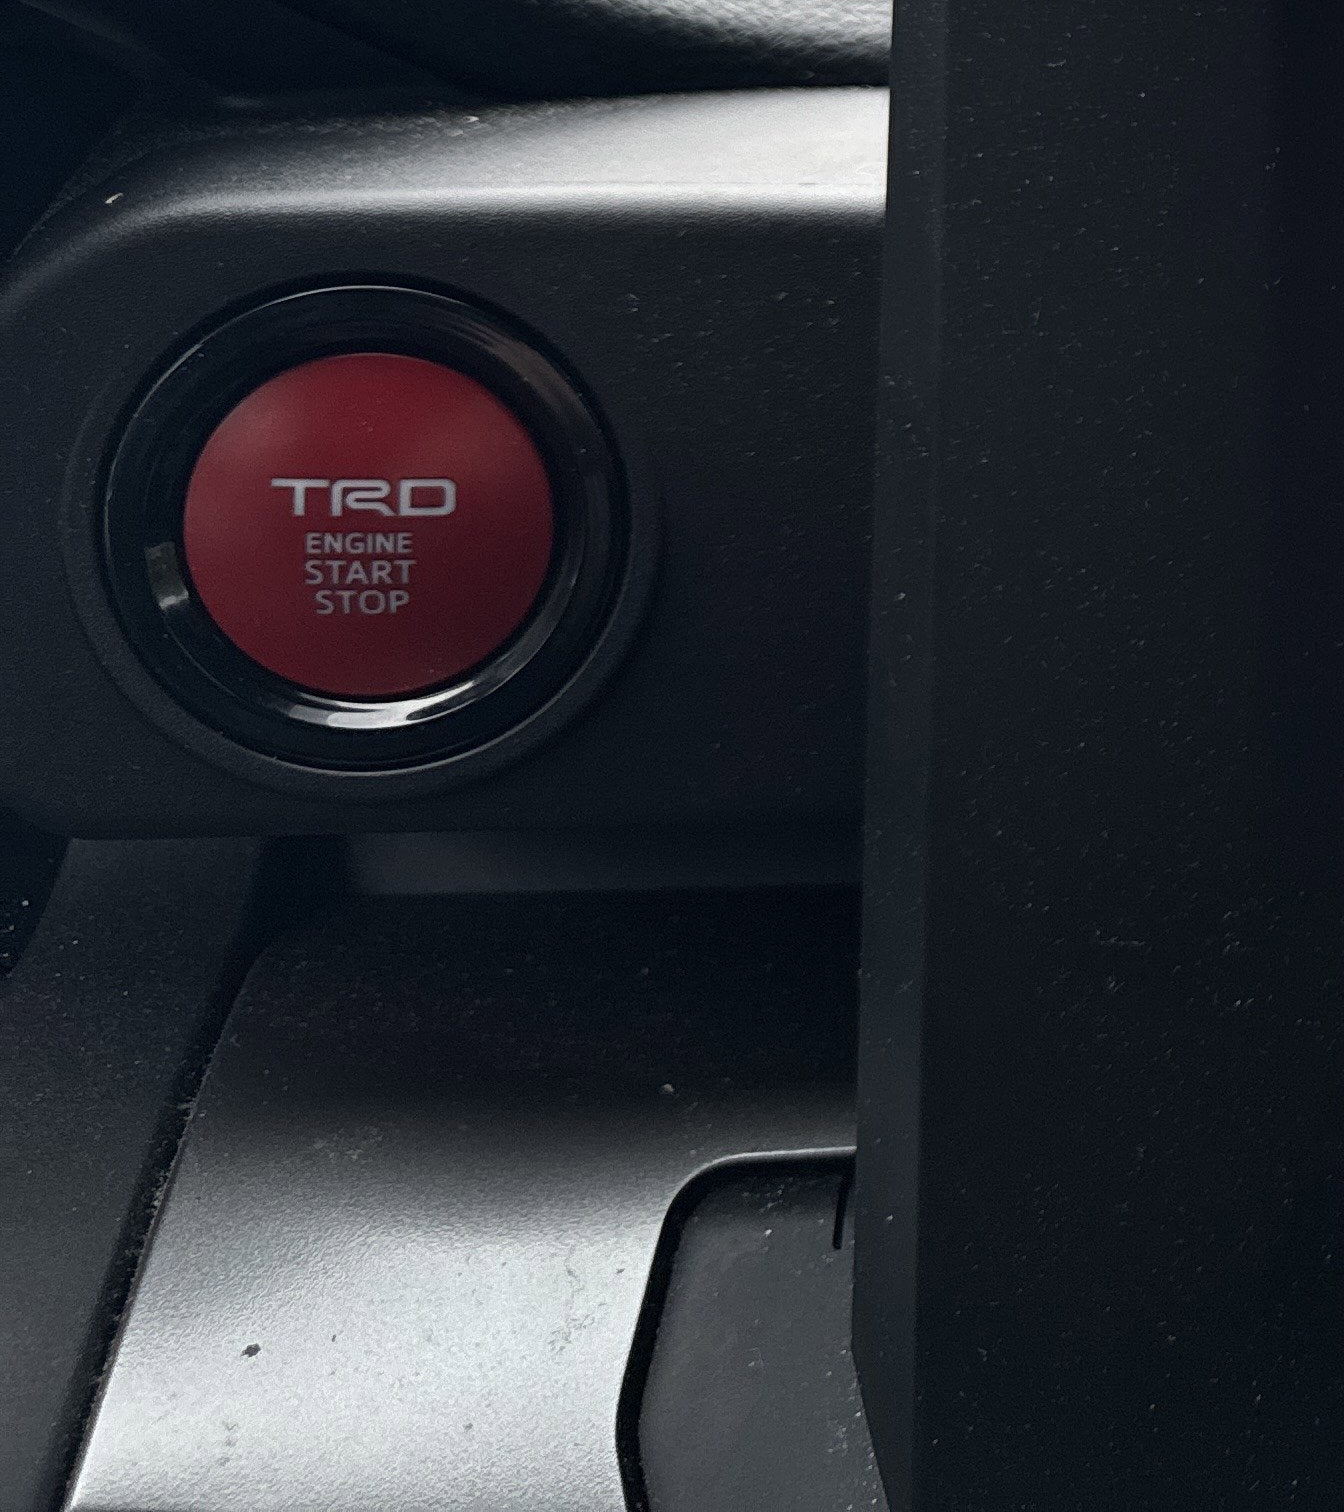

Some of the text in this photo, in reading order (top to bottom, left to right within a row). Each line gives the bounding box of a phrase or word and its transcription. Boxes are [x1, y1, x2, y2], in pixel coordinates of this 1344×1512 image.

[271, 478, 457, 516] TRD
[305, 532, 413, 554] ENGINE
[305, 560, 417, 584] START
[314, 589, 410, 615] STOP
